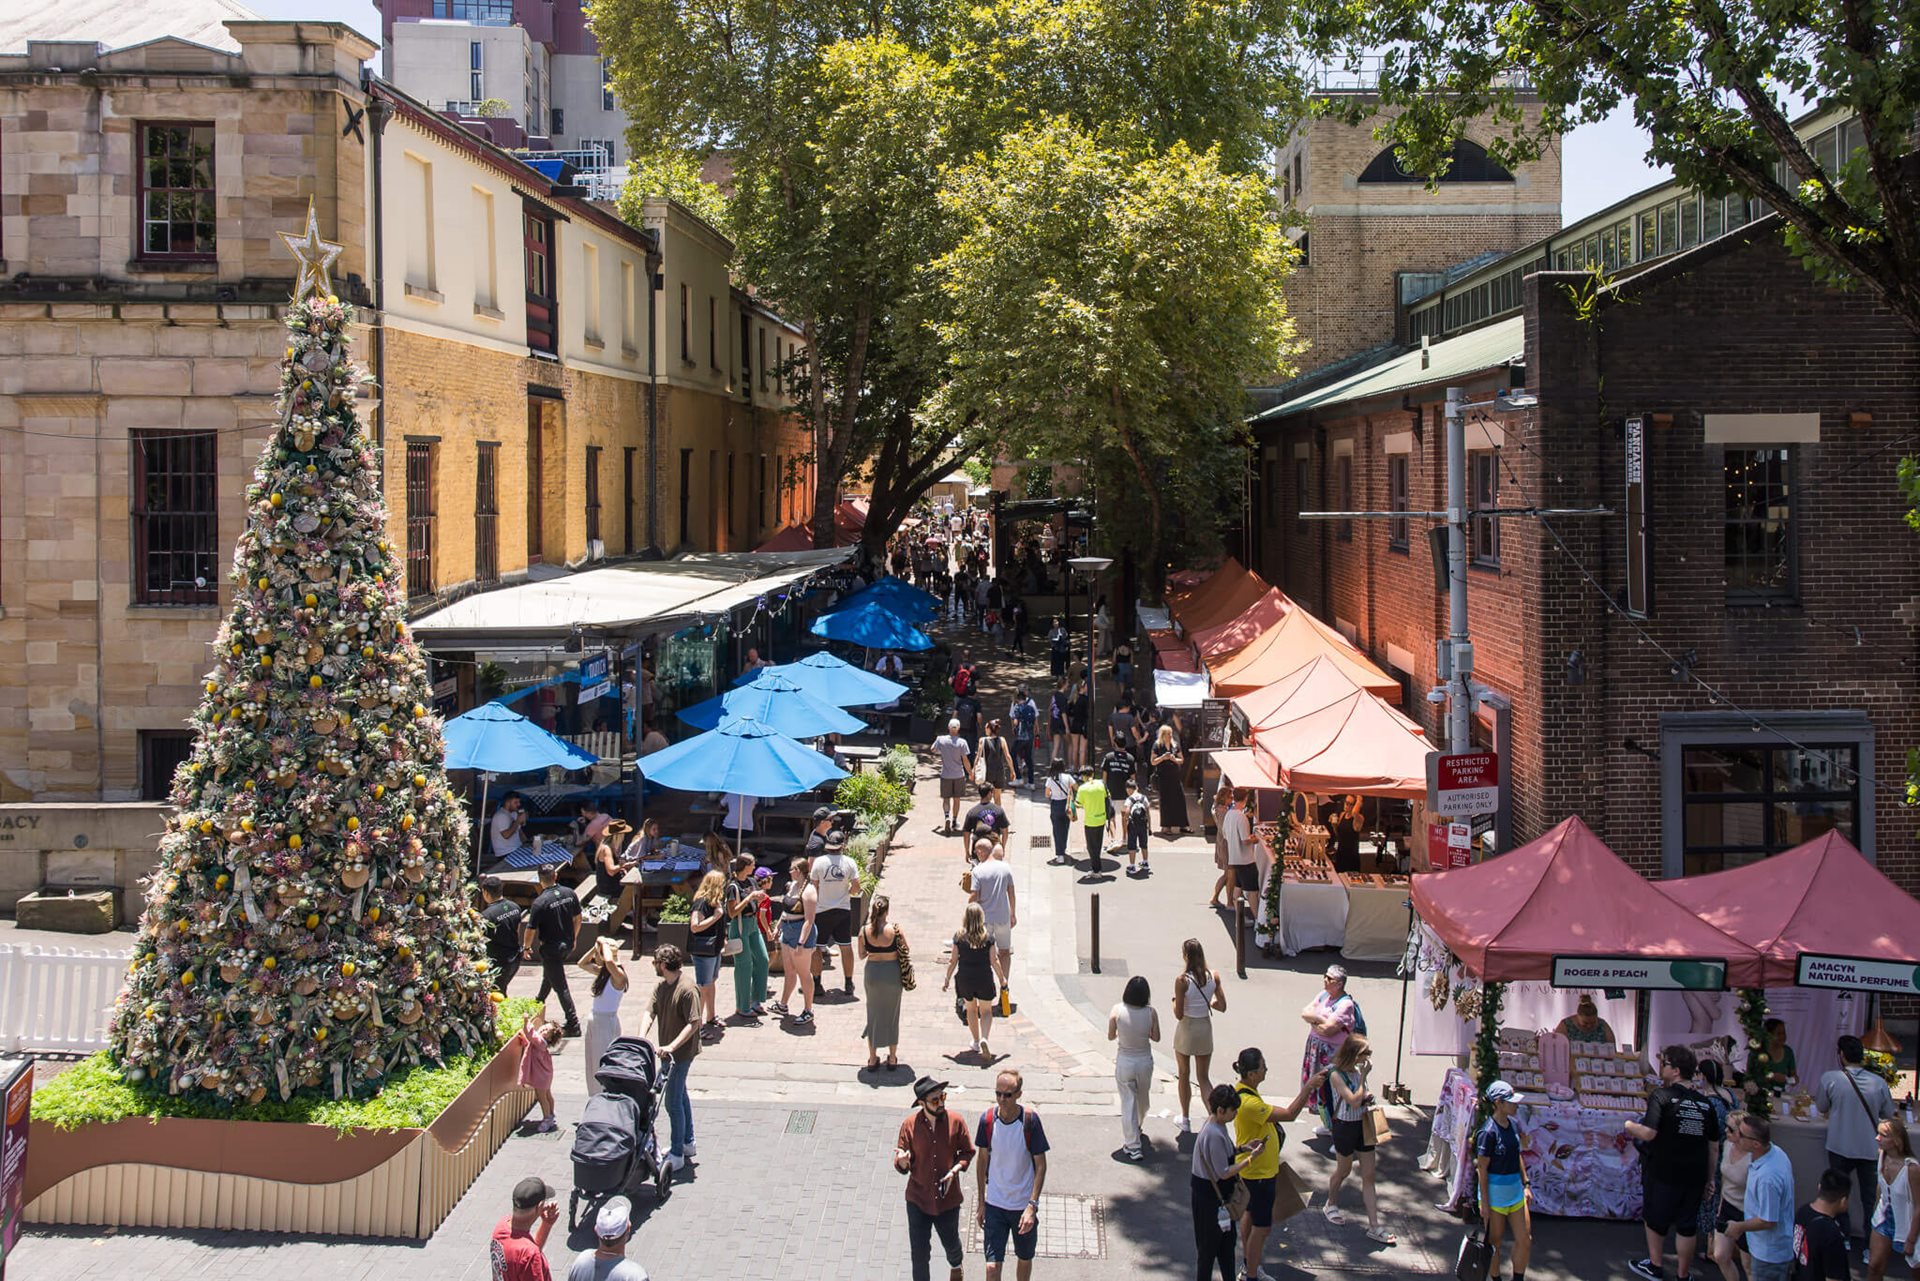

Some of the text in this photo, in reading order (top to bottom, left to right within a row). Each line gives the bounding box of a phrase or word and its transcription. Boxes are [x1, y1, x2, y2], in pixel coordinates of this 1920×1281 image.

[1446, 757, 1490, 767] RESTRICTED
[1452, 766, 1484, 776] PARKING
[1457, 775, 1479, 784] AREA
[1447, 791, 1490, 802] AUTHORISED
[1443, 801, 1493, 812] PARKING ONLY
[0, 816, 41, 829] ACY
[496, 909, 520, 921] SECURITY
[1564, 968, 1648, 978] ROGER & PEACH
[1809, 962, 1856, 973] AMACYN
[1808, 972, 1910, 988] NATURAL PERFUME
